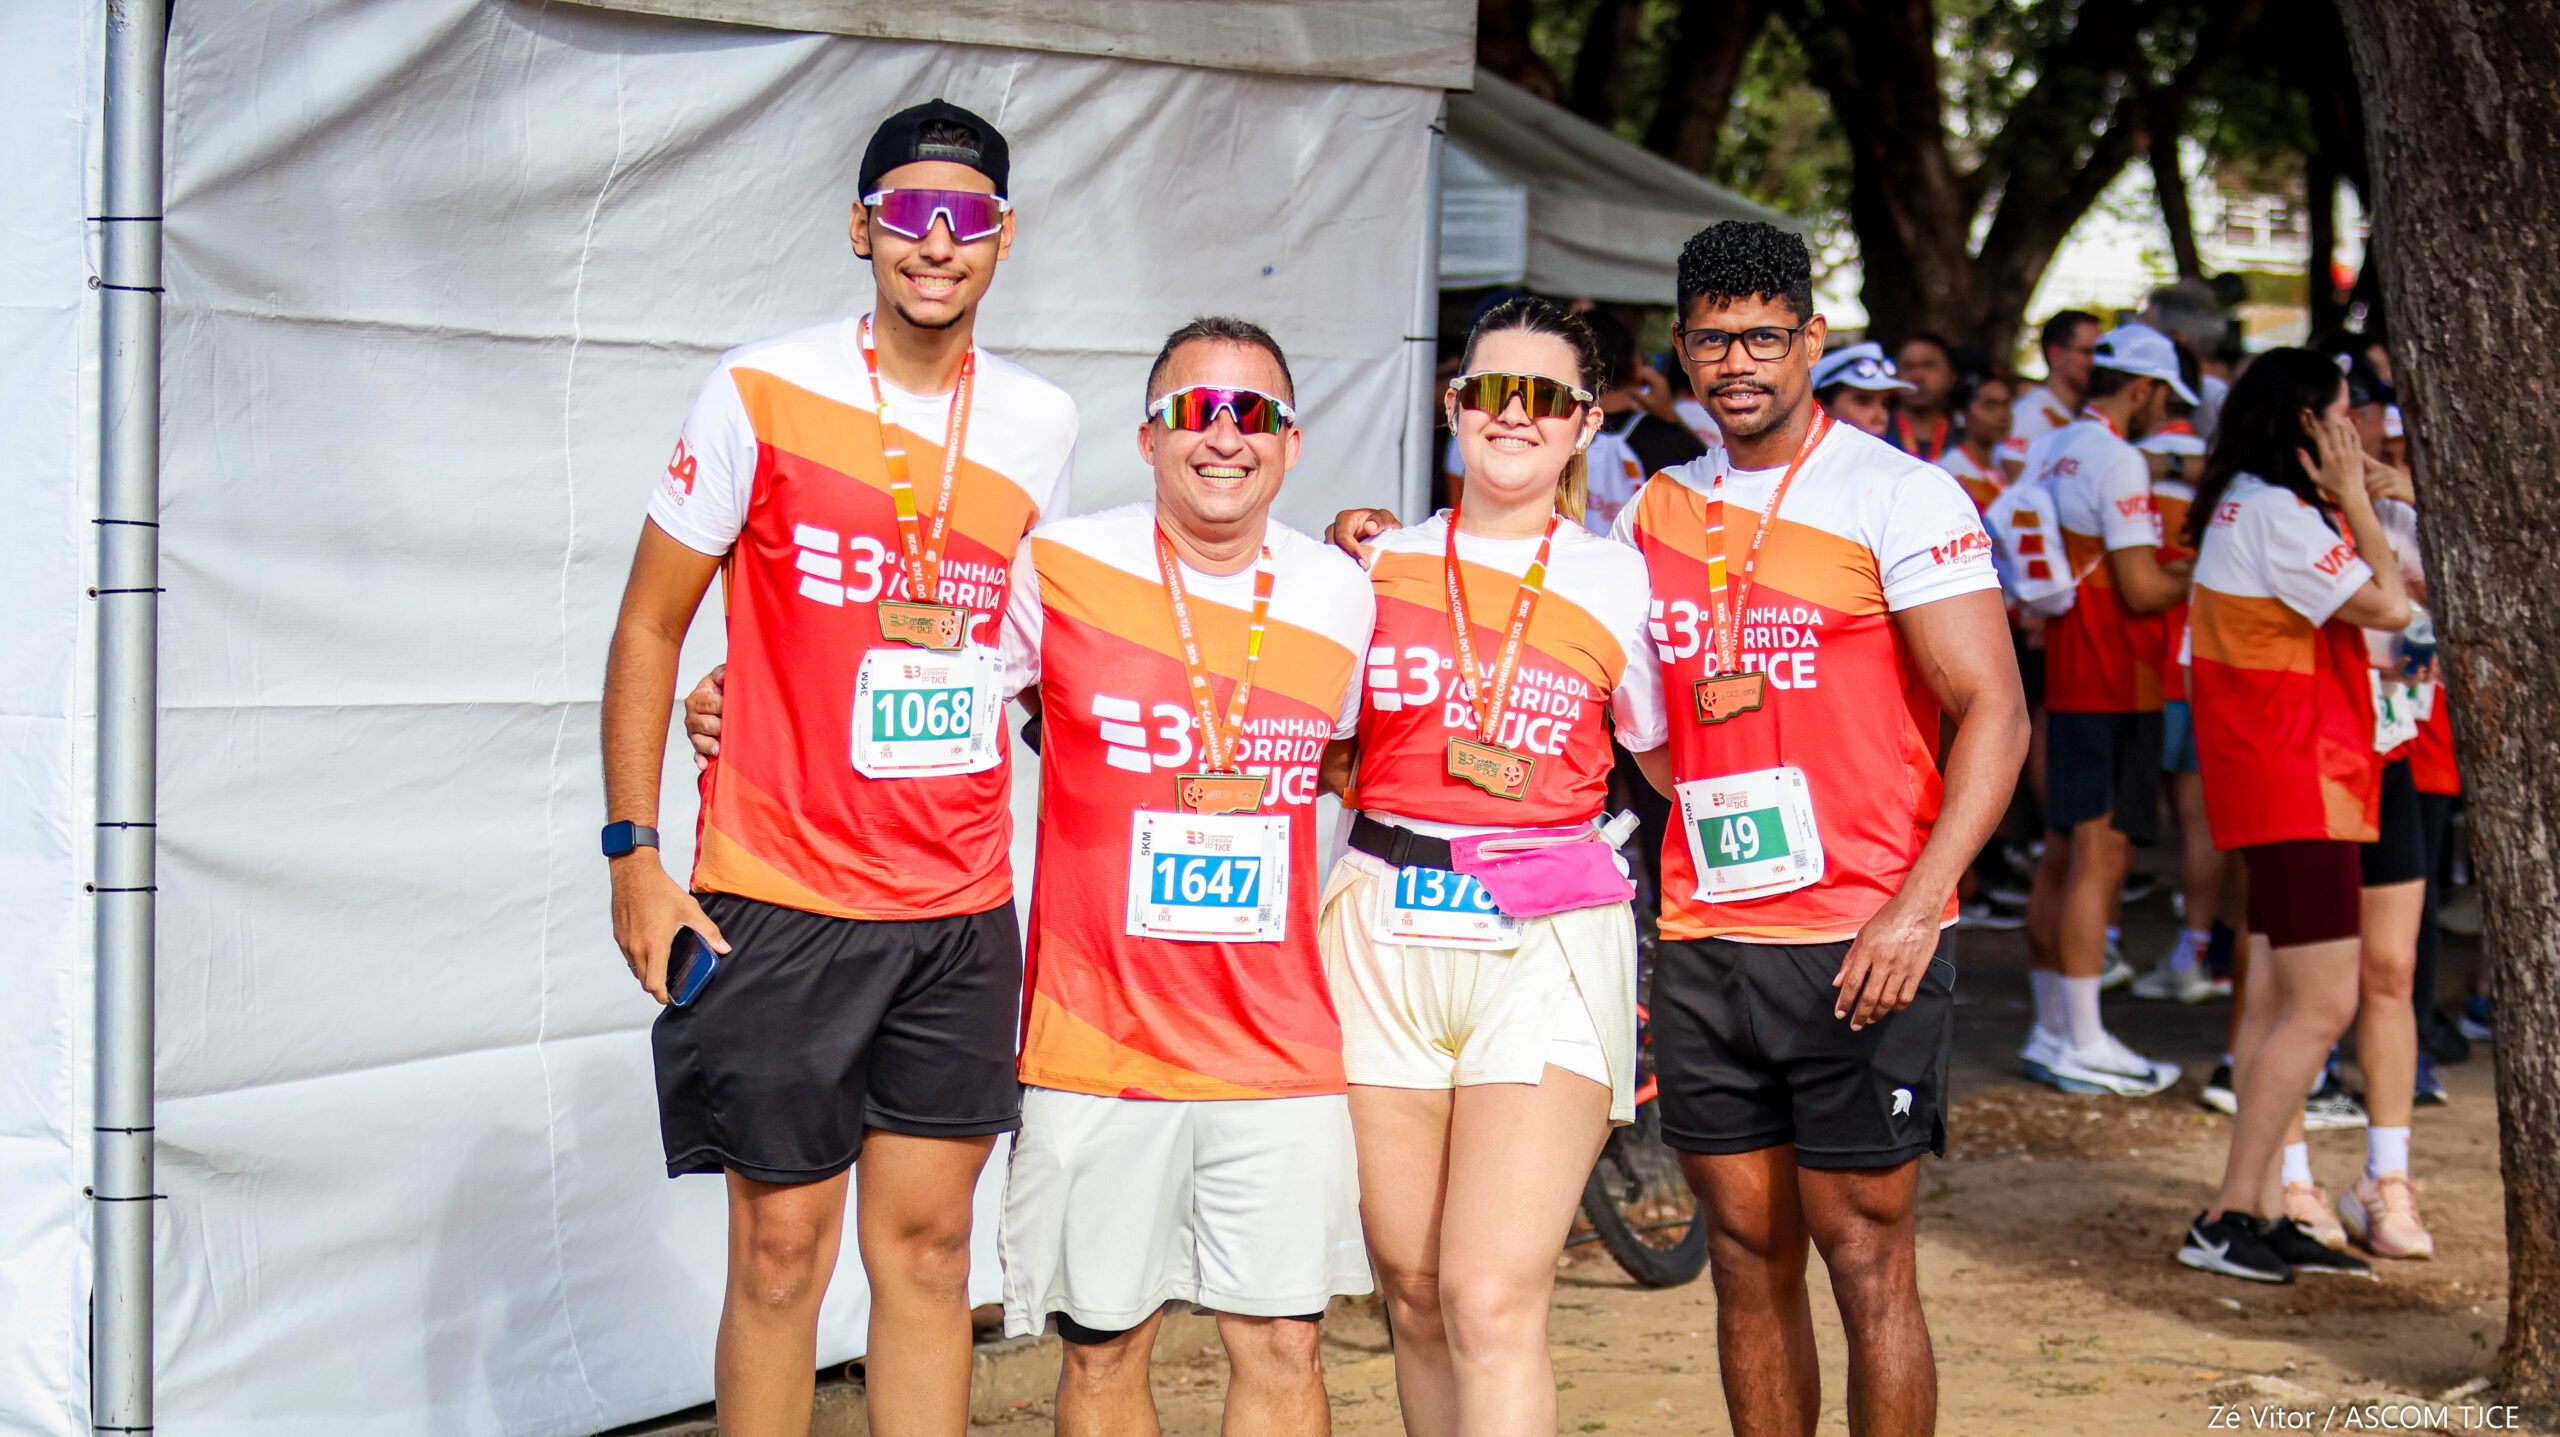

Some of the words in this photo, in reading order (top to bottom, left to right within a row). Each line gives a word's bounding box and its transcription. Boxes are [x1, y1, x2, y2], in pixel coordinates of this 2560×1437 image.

[942, 474, 952, 491] DO
[938, 491, 950, 512] TJCE
[932, 517, 945, 539] 2026
[906, 532, 919, 556] 2026
[911, 561, 922, 582] TJCE
[916, 583, 927, 599] DO
[1175, 603, 1186, 617] DO
[1517, 600, 1530, 618] 2026
[1717, 602, 1726, 624] 2026
[1180, 619, 1192, 639] TJCE
[1511, 622, 1523, 639] TJCE
[1671, 601, 1709, 659] 3ª
[1704, 627, 1820, 650] /RRIDA
[1719, 629, 1729, 648] TJCE
[1185, 643, 1198, 665] 2026
[1459, 638, 1469, 652] DO
[1506, 641, 1517, 654] DO
[1462, 653, 1474, 672] TJCE
[1722, 648, 1731, 665] DO
[860, 671, 869, 696] 3KM
[1403, 647, 1453, 706] 3ª
[1466, 678, 1478, 700] 2026
[876, 690, 971, 737] 1068
[1241, 718, 1332, 739] MINHADA
[1497, 711, 1573, 756] TJCE
[1685, 802, 1694, 826] 3KM
[1141, 831, 1151, 856] 5KM
[1720, 815, 1760, 861] 49
[1156, 857, 1260, 903] 1647
